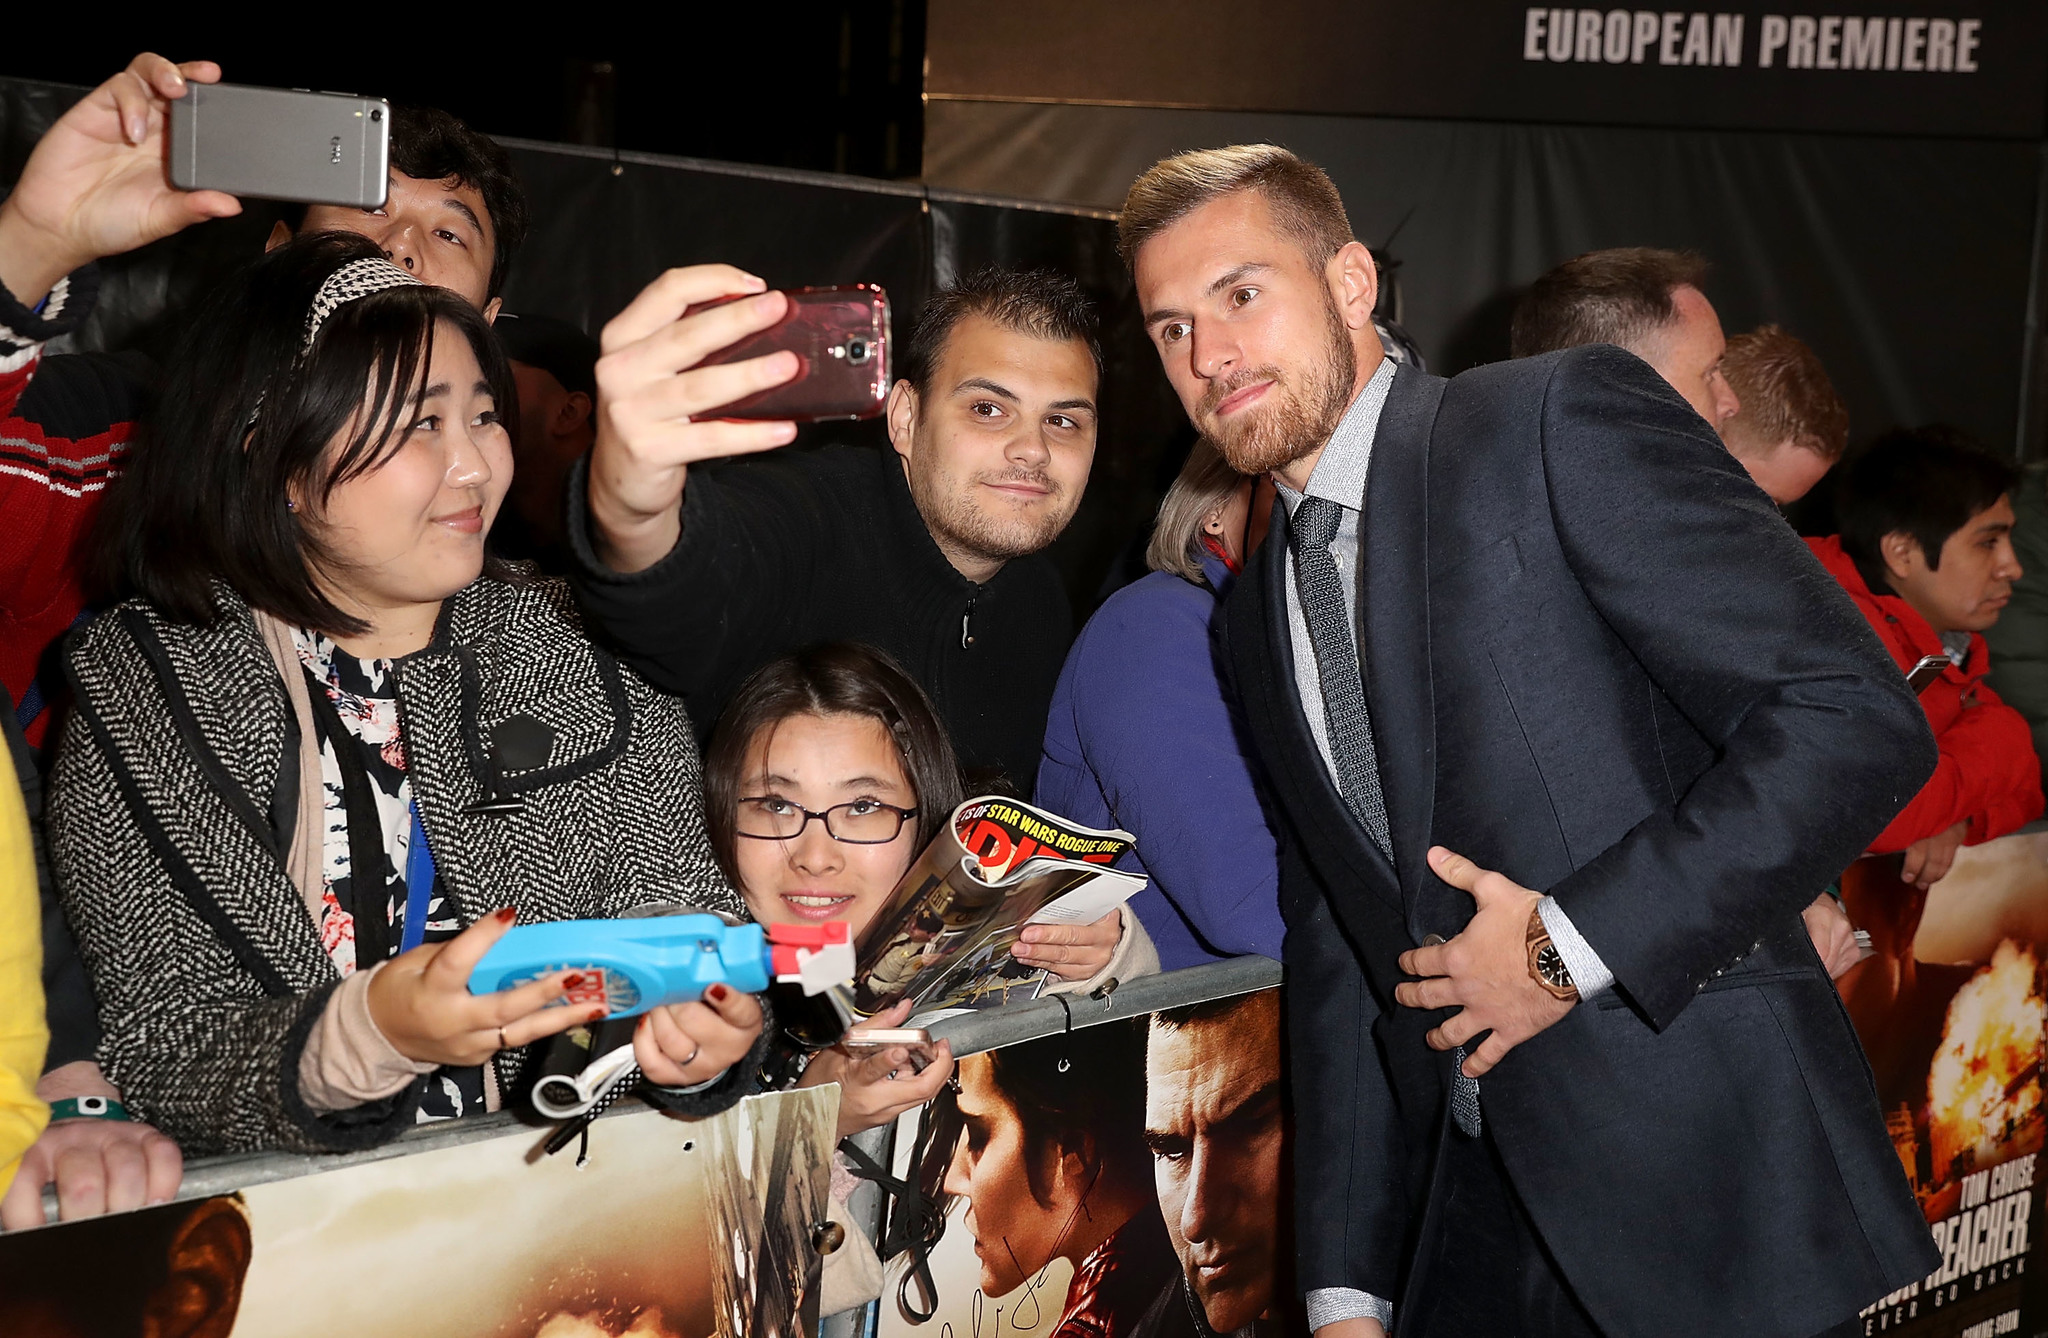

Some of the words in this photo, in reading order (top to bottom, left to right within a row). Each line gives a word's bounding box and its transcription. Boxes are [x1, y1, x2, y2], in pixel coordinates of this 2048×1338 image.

[1523, 8, 1745, 67] EUROPEAN
[1758, 15, 1982, 72] PREMIERE
[972, 804, 991, 819] OF
[986, 804, 1020, 827] STAR
[1020, 815, 1058, 845] WARS
[1056, 833, 1098, 854] ROGUE
[1096, 841, 1124, 854] ONE
[1989, 1153, 2037, 1199] CRUISE
[1934, 1283, 1959, 1308] GO
[1974, 1257, 2025, 1291] BACK
